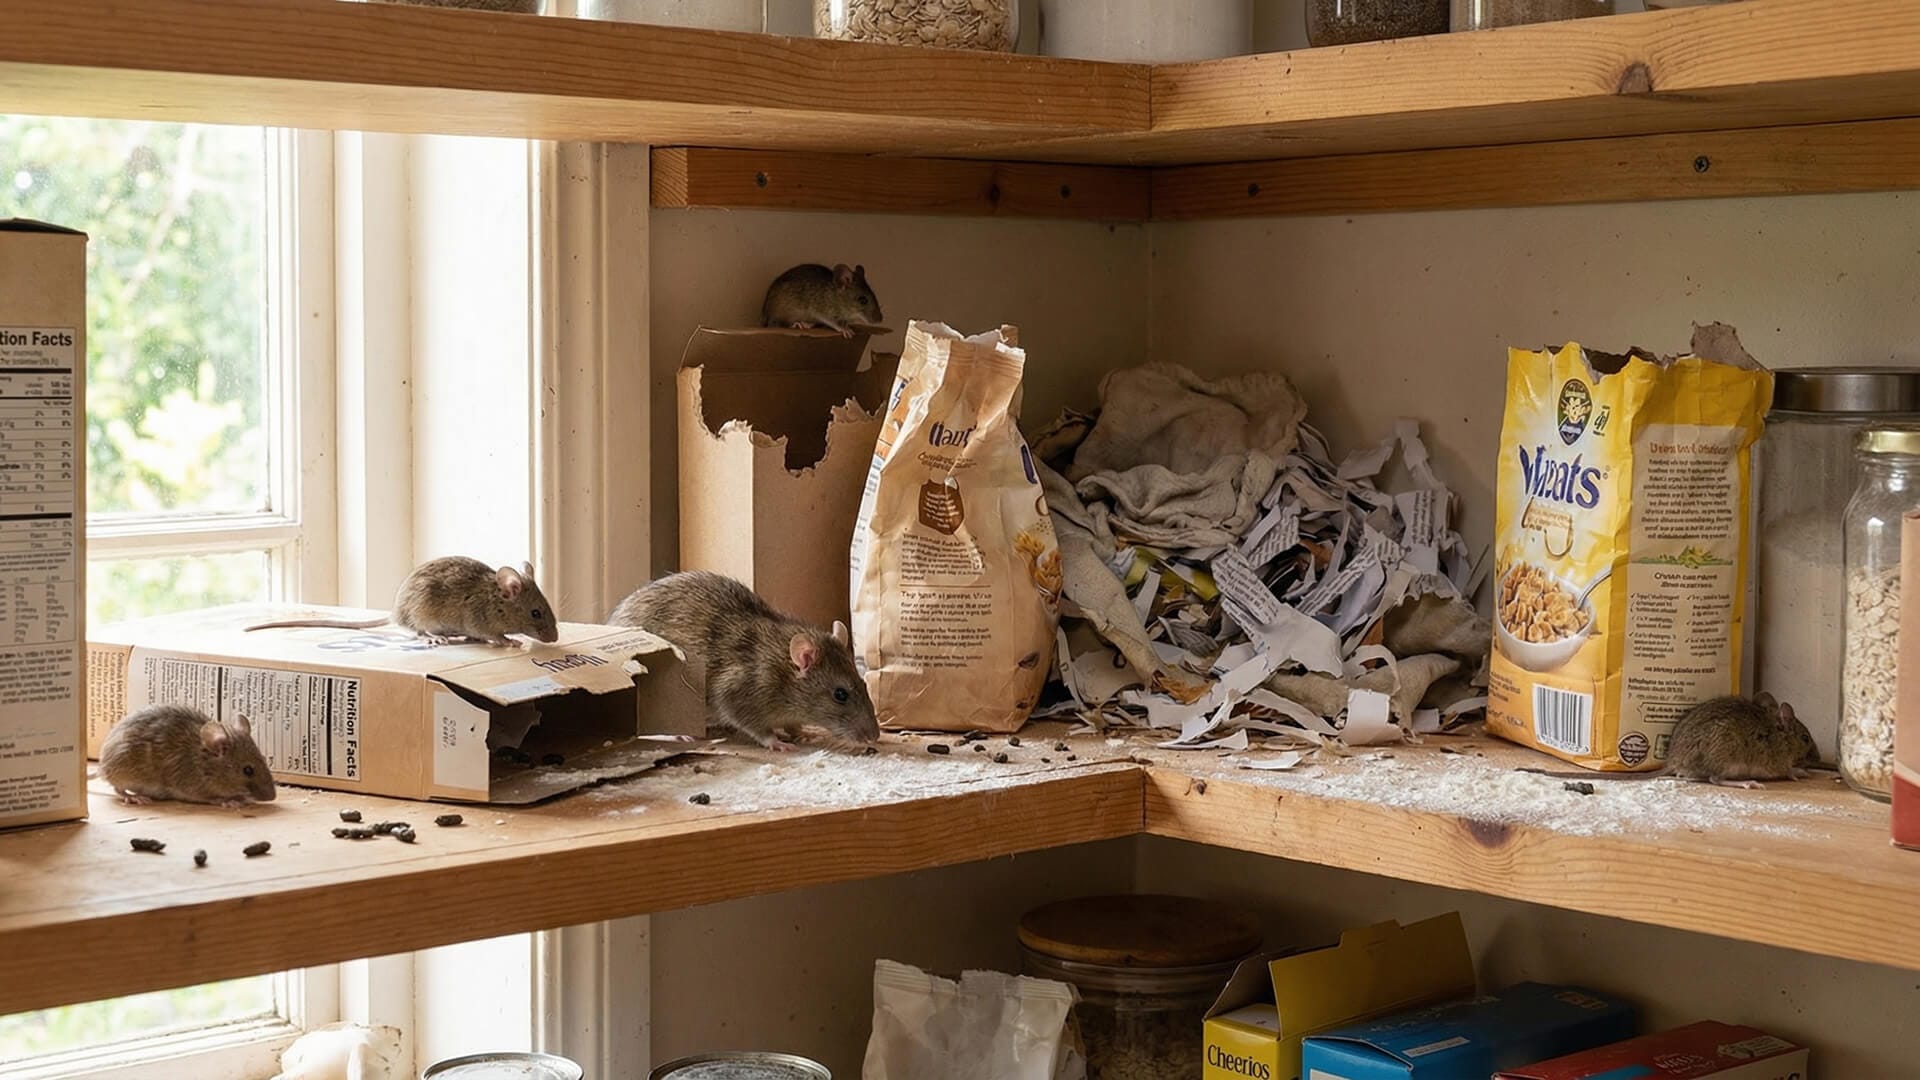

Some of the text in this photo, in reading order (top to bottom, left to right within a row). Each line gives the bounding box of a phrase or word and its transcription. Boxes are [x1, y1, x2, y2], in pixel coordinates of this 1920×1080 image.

[32, 331, 72, 346] Facts
[346, 680, 358, 777] Nutrition Facts
[1207, 1044, 1270, 1080] Cheerios
